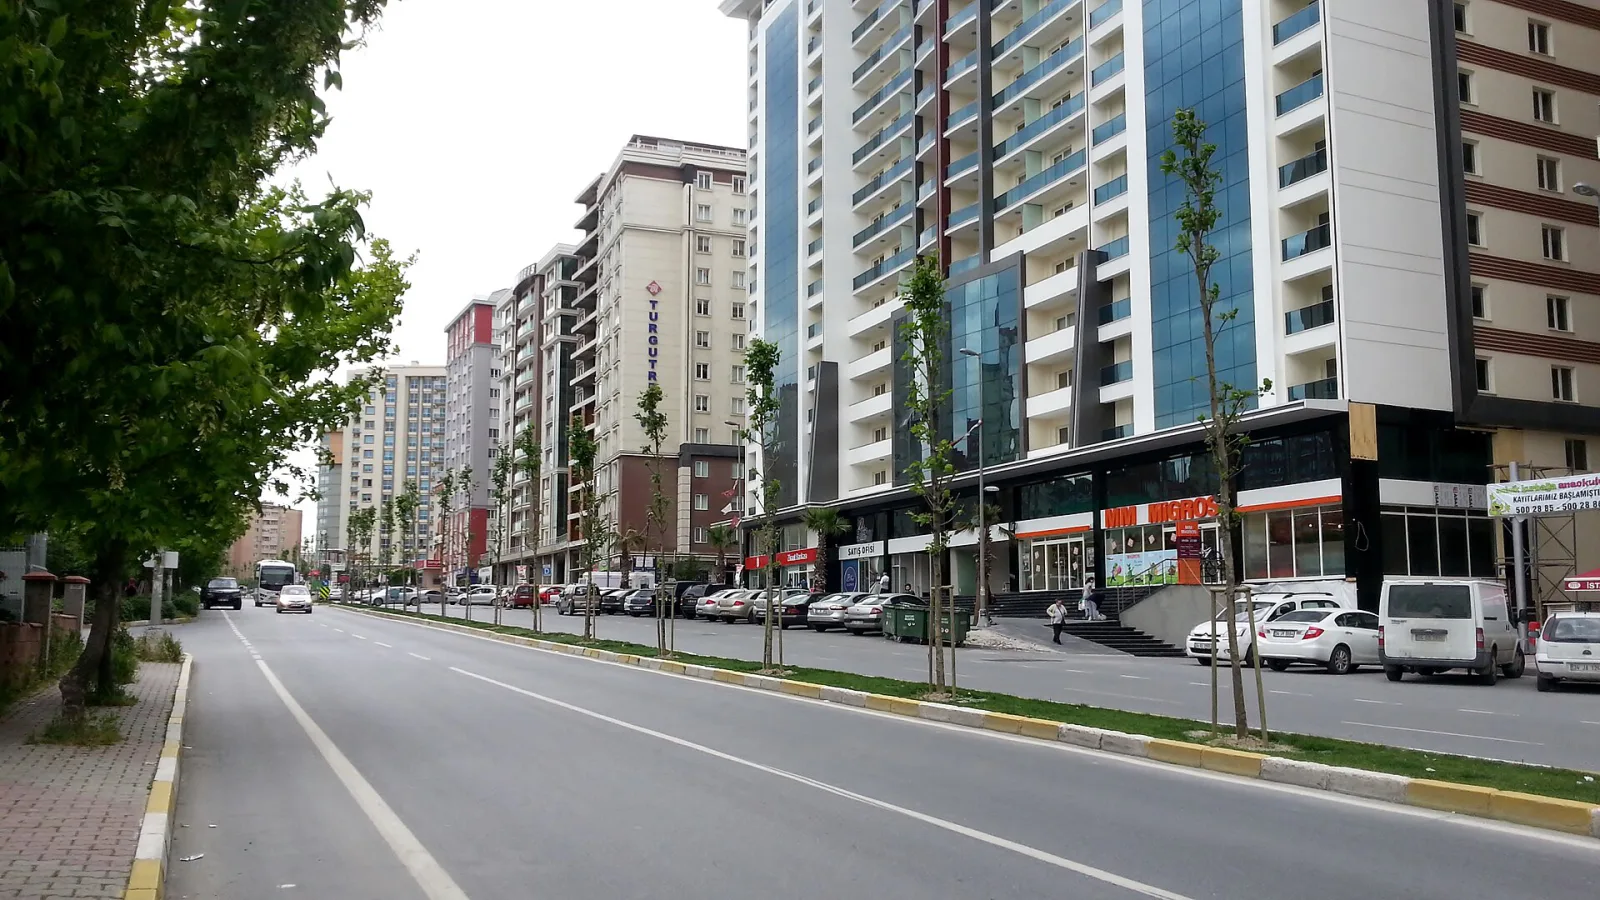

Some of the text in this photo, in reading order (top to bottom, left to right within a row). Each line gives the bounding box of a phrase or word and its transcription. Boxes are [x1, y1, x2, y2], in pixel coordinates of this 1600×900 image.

[1516, 506, 1530, 514] 500
[1562, 503, 1577, 511] 500
[1580, 501, 1590, 509] 28
[1106, 506, 1137, 528] MM
[848, 543, 875, 556] SATIŞ OFİSİ
[1586, 581, 1600, 589] İST
